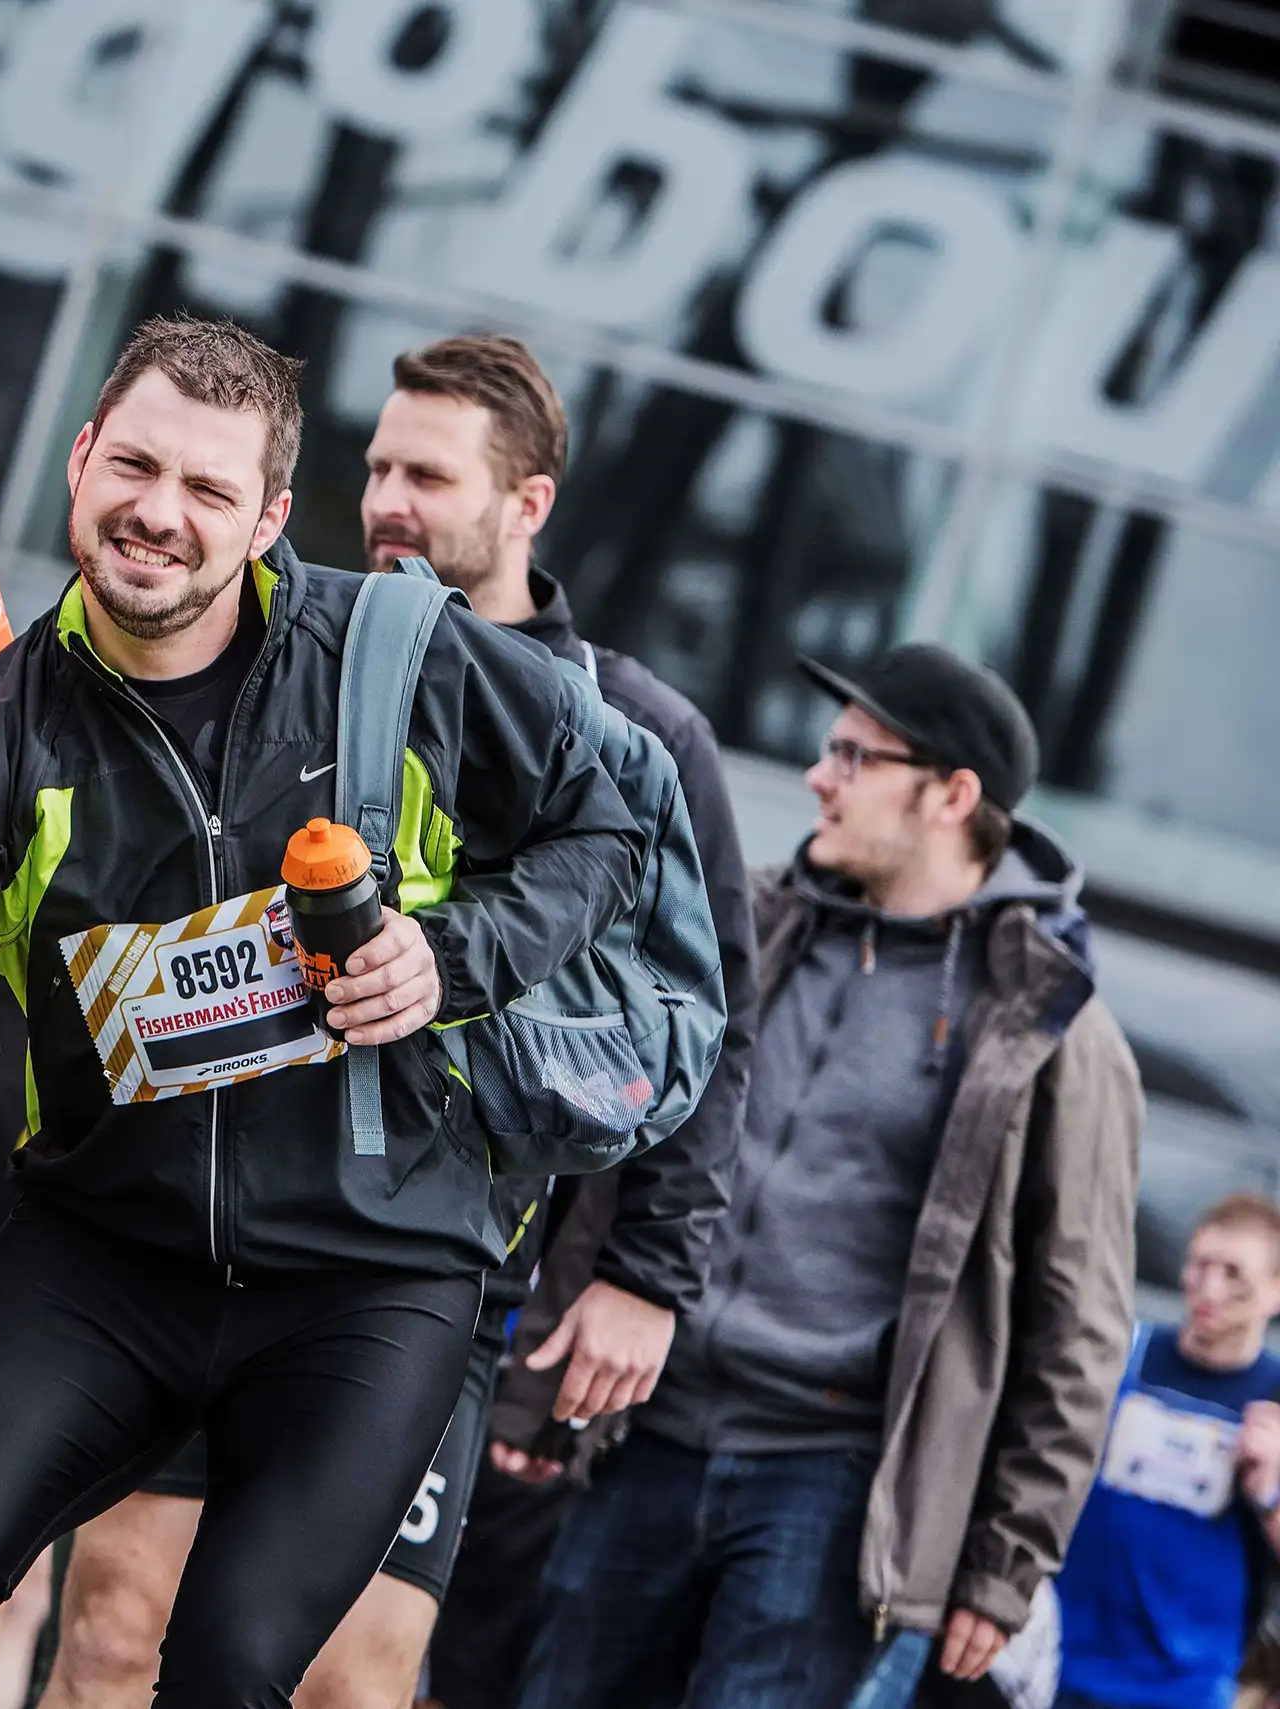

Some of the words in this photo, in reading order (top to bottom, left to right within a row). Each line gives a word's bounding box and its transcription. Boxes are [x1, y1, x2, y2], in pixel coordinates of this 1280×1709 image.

[170, 939, 263, 1000] 8592
[134, 996, 248, 1039] FISHERMAN'S
[213, 1054, 268, 1075] BROOKS
